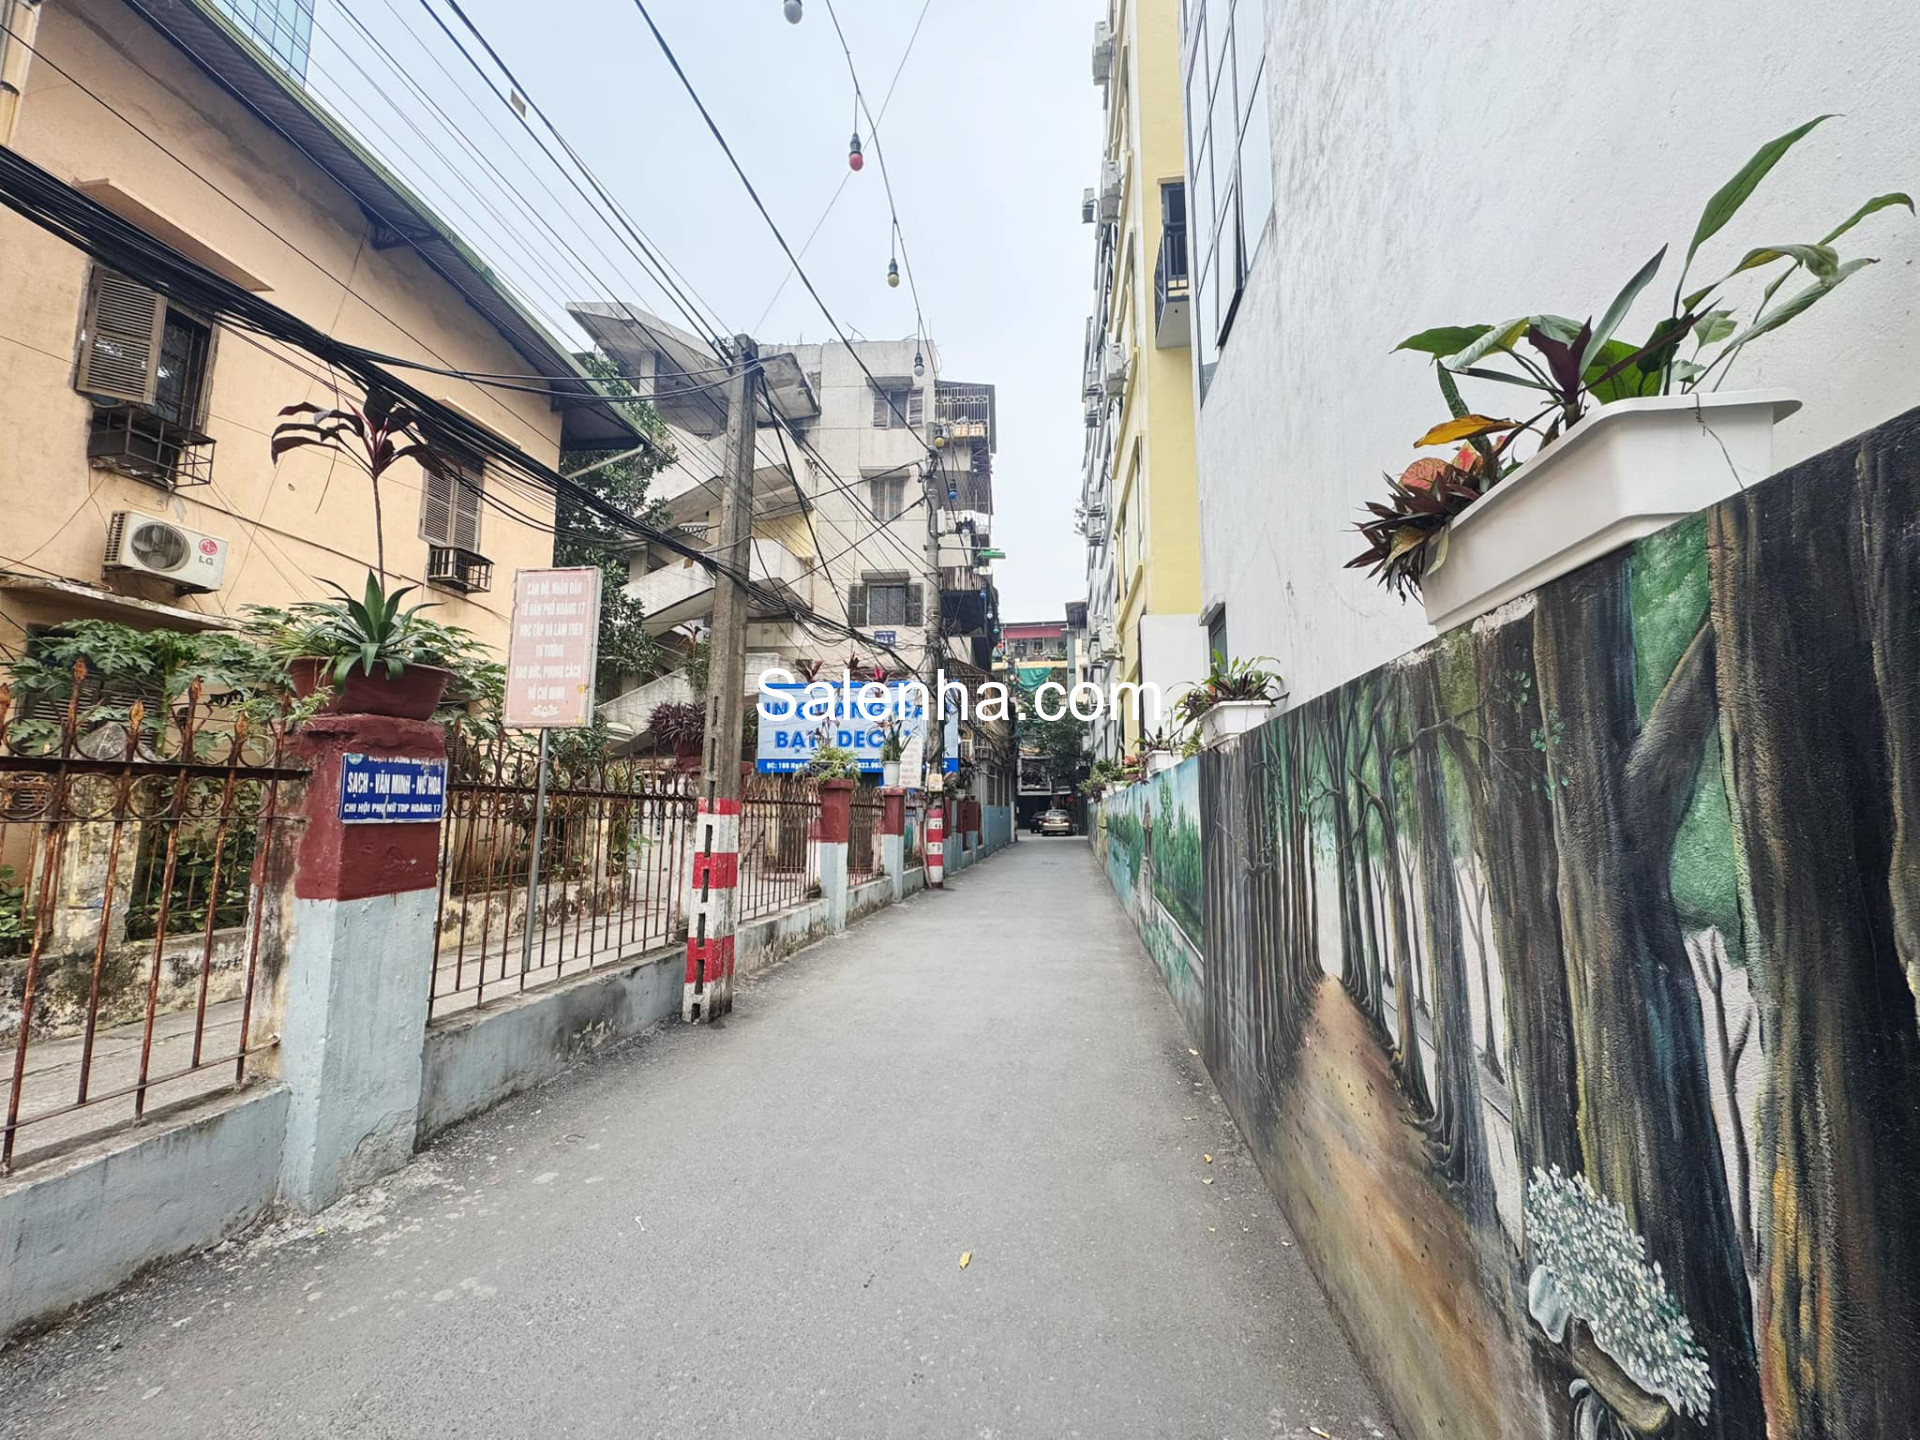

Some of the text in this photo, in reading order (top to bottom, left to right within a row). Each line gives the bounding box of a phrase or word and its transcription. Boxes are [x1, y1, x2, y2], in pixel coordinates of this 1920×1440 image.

[199, 556, 213, 566] LG
[565, 662, 581, 678] CÁCH
[347, 771, 369, 798] SẠCH
[375, 769, 391, 795] VĂN
[391, 774, 412, 795] MINH
[428, 776, 441, 795] HOA
[344, 803, 357, 813] CHI
[357, 801, 371, 815] HỘI
[397, 803, 410, 813] TDP
[410, 801, 433, 813] HOÀNG
[433, 803, 441, 814] 17
